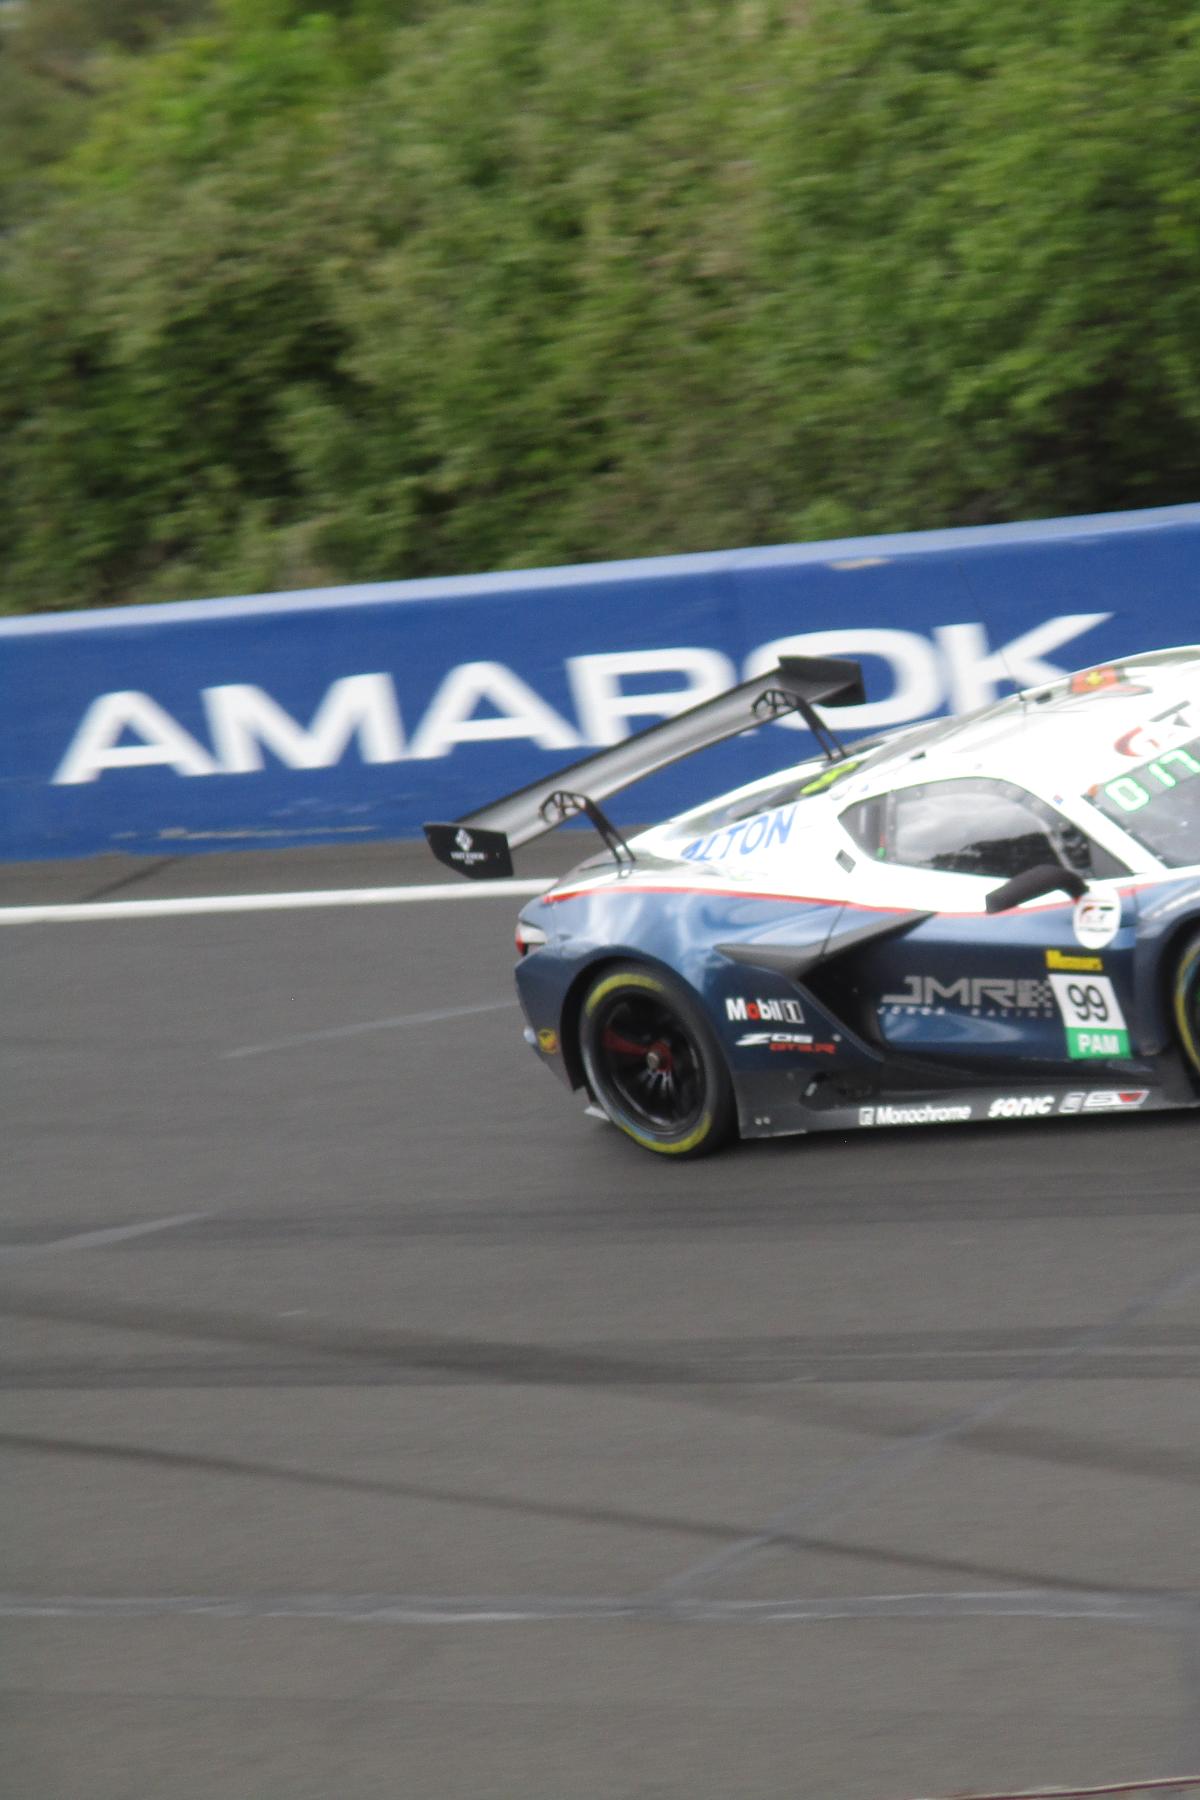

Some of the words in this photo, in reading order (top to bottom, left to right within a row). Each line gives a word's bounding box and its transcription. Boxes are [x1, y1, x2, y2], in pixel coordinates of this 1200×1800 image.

[51, 613, 1113, 784] AMAROK
[725, 998, 783, 1021] Mobil
[1068, 984, 1108, 1021] 99
[1077, 1033, 1120, 1055] PAM
[876, 1104, 972, 1125] Monochrome
